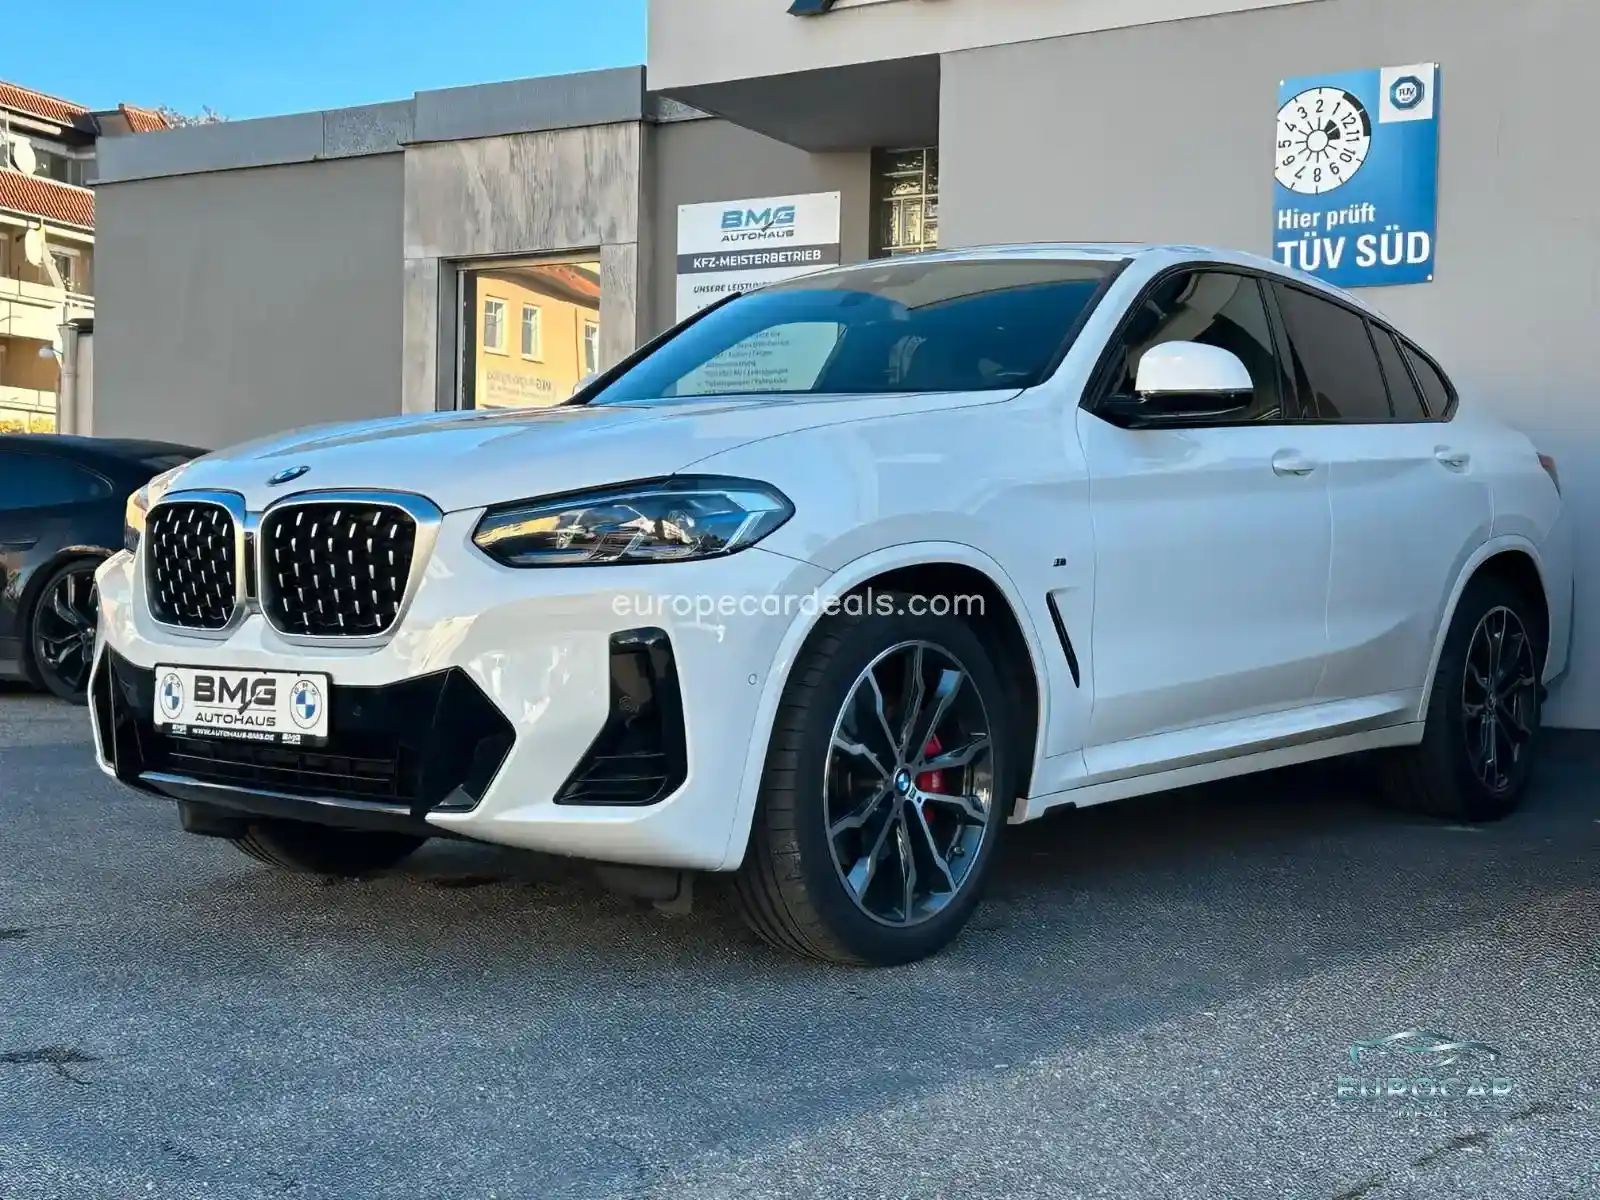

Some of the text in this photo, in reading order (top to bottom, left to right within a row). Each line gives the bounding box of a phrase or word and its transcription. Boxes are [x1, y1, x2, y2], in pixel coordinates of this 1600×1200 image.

[1297, 106, 1308, 119] 3
[1316, 99, 1324, 113] 2
[1332, 102, 1340, 115] 1
[1285, 122, 1297, 132] 4
[1340, 112, 1356, 129] 12
[1345, 130, 1360, 142] 11
[1278, 139, 1292, 149] 5
[1339, 148, 1356, 163] 10
[1294, 166, 1306, 179] 7
[1313, 167, 1321, 182] 8
[721, 205, 795, 230] BMG
[1278, 202, 1376, 231] Hier prüft
[721, 230, 795, 242] AUTOHAUS
[1277, 224, 1430, 271] TÜV SÜD
[693, 249, 822, 268] KFZ-MEISTERBETRIEB
[693, 284, 727, 294] UNSERE
[194, 675, 277, 707] BMG
[194, 712, 277, 727] AUTOHAUS
